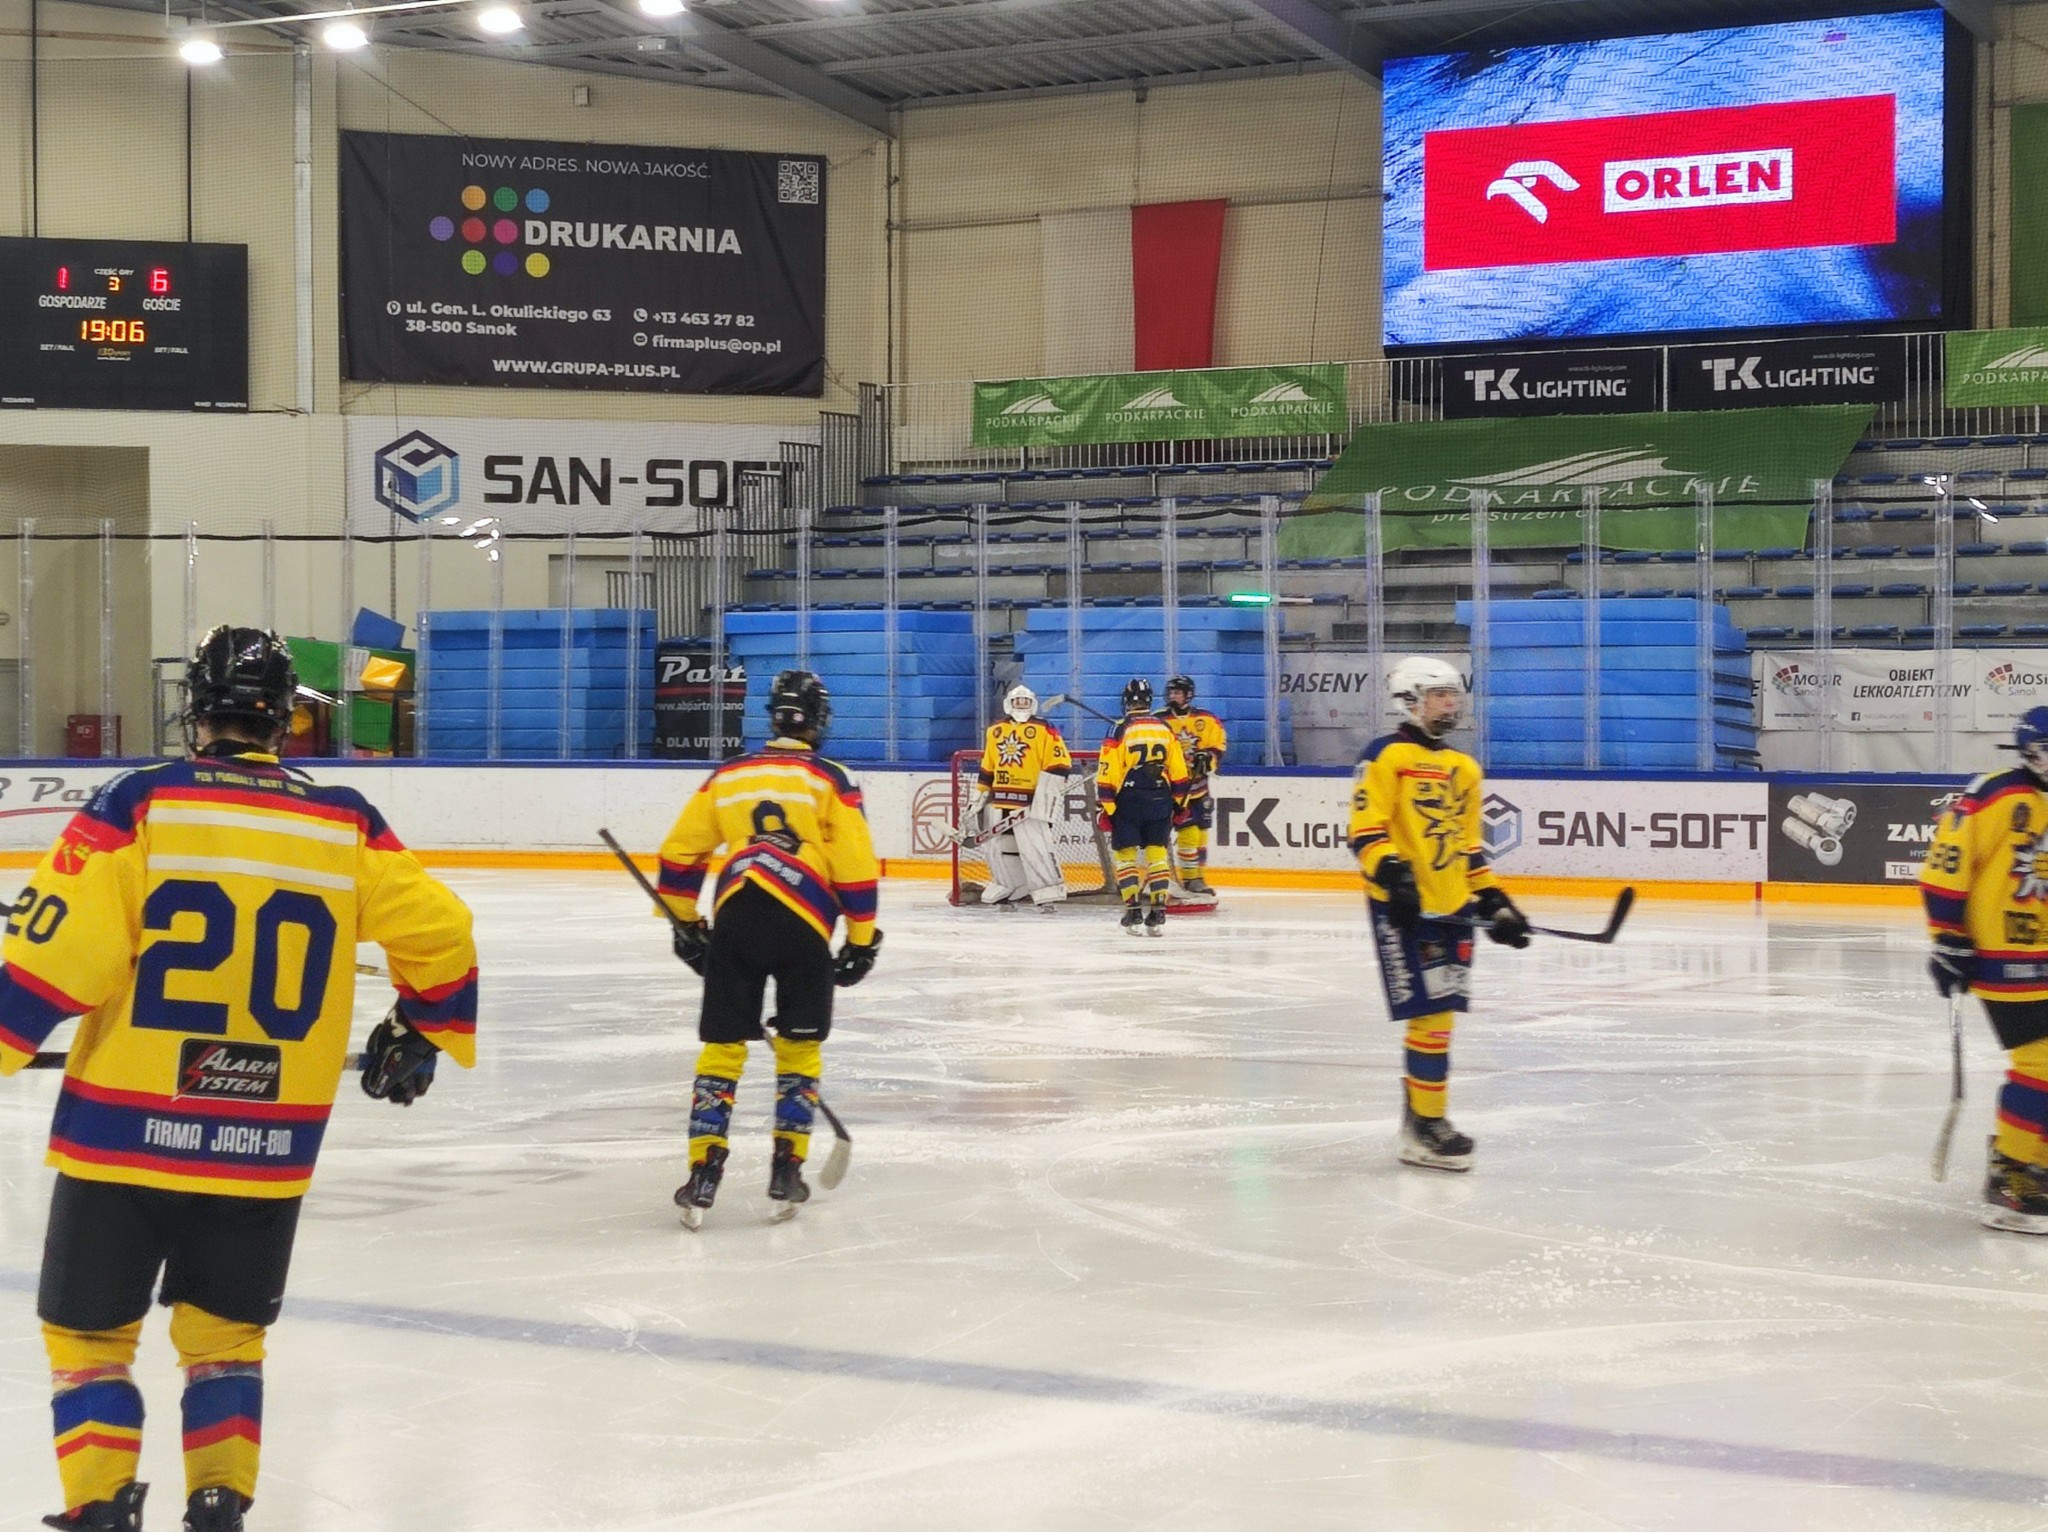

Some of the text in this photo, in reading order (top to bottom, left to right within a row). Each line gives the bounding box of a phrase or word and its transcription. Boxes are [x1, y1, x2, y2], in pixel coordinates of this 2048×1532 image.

[462, 153, 516, 169] NOWY
[520, 156, 581, 173] ADRES.
[585, 159, 640, 175] NOWA
[1615, 160, 1781, 201] ORLEN
[525, 220, 742, 254] DRUKARNIA
[109, 276, 120, 291] 3
[153, 269, 168, 292] 6
[38, 295, 107, 309] GOSPODARZE
[143, 295, 181, 311] GOŚCIE
[406, 302, 611, 323] ul. Gen. L. Okulickiego 63
[653, 311, 755, 328] +13 463 27 82
[81, 320, 144, 342] 19:06
[406, 319, 517, 337] 38-500 Sanok
[652, 334, 782, 354] firmaplus@op.pl
[493, 359, 680, 379] WWW.GRUPA-PLUS.PL
[1765, 367, 1876, 388] LIGHTING
[1523, 379, 1628, 399] LIGHTING
[1105, 408, 1206, 423] PODKARPACKIE
[1231, 402, 1335, 418] PODKARPACKIE
[985, 413, 1083, 428] PODKARPACKIE
[1279, 673, 1368, 693] BASENY
[1889, 668, 1935, 682] OBIEKT
[666, 737, 690, 748] DLA
[1538, 811, 1766, 849] SAN-SOFT
[5, 886, 68, 945] 20
[131, 879, 338, 1042] 20
[199, 1047, 279, 1075] ALARM
